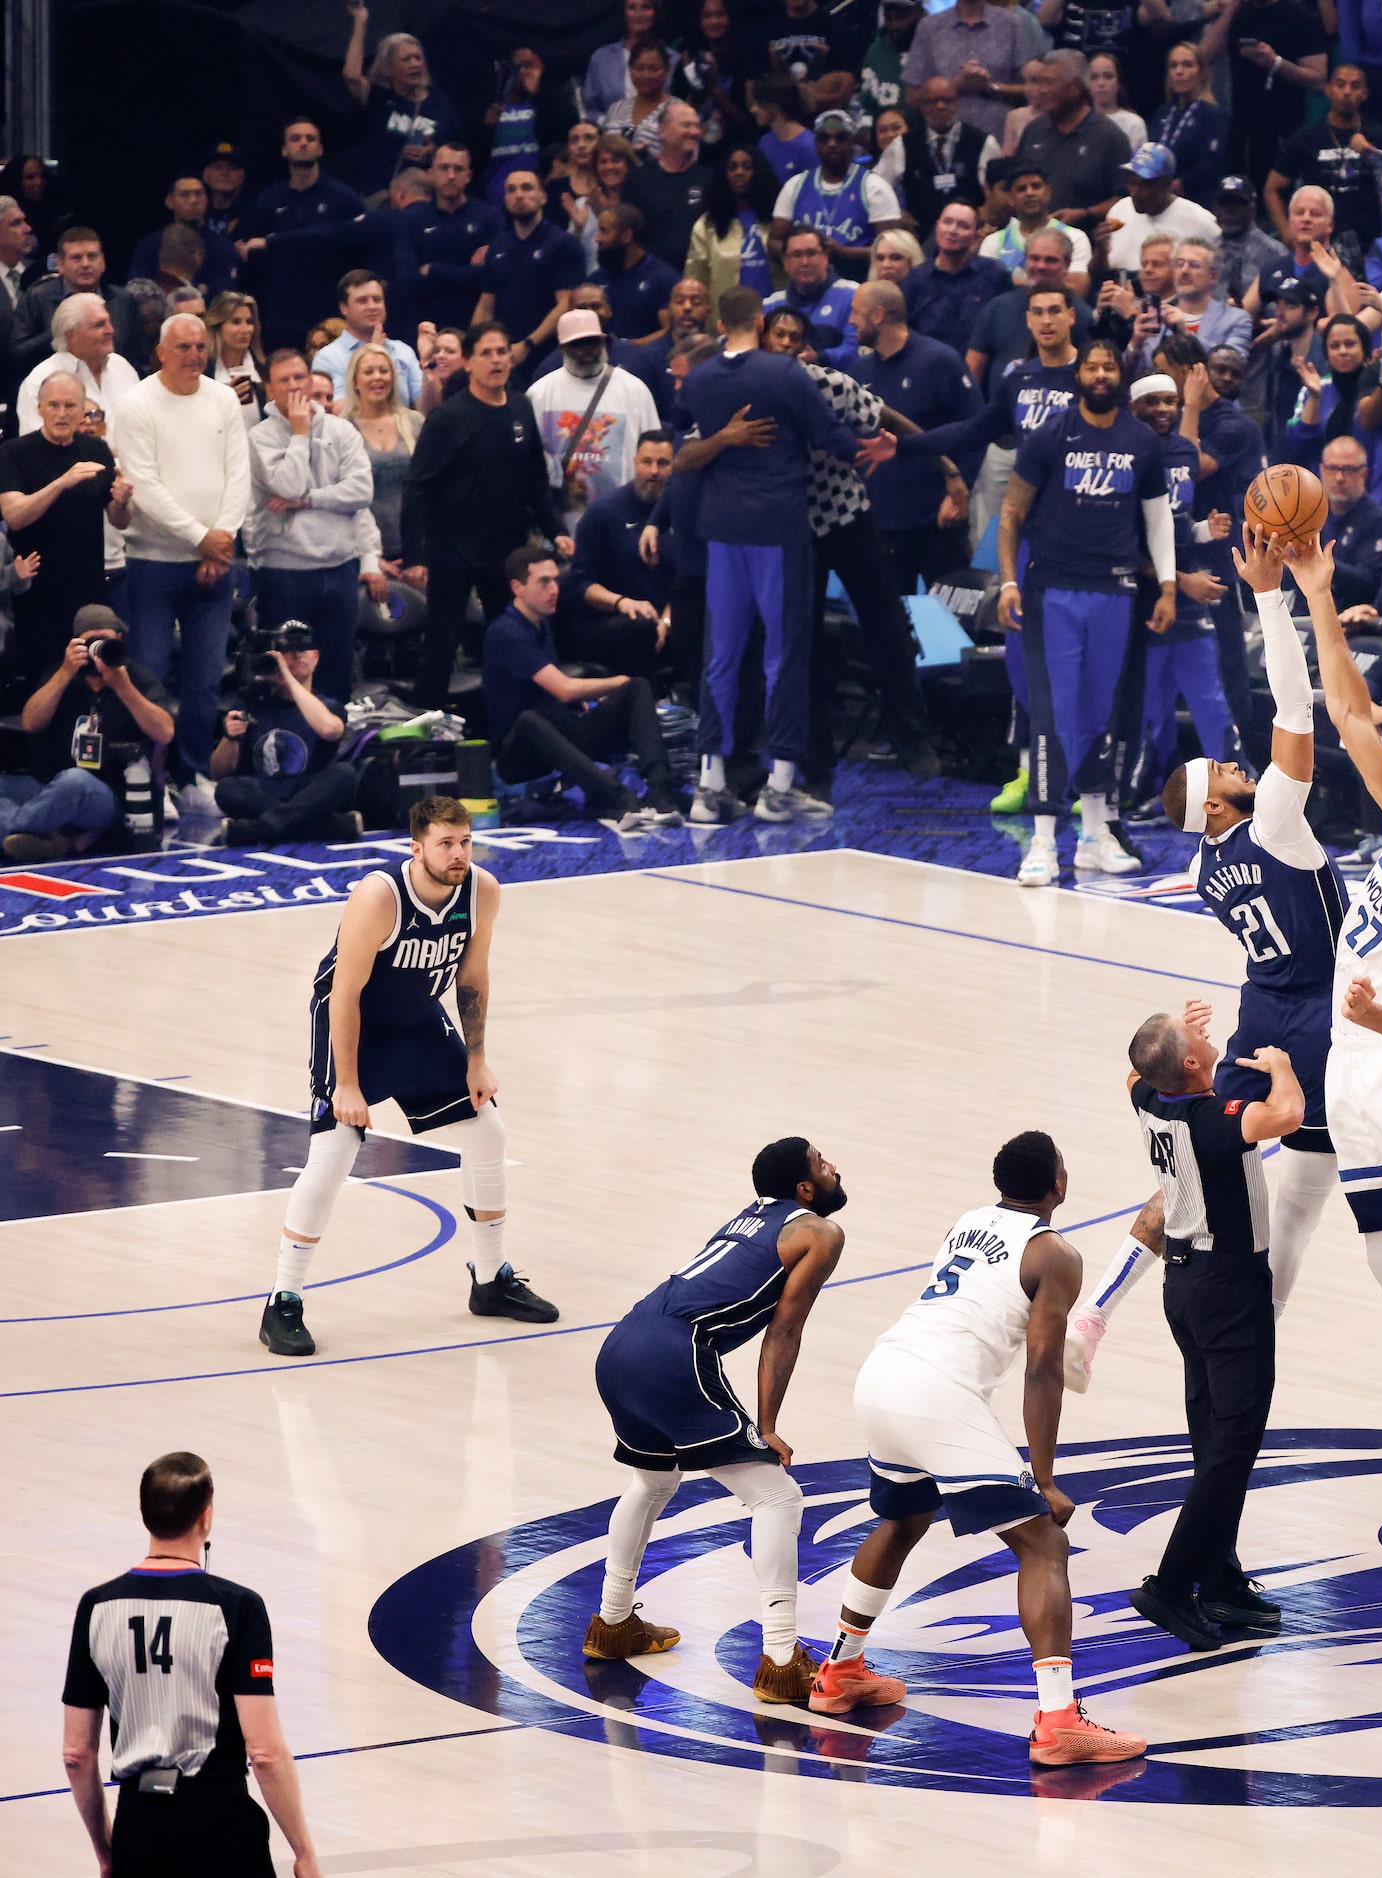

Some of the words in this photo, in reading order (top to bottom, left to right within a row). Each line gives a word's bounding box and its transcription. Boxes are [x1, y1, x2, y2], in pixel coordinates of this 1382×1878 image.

[1107, 453, 1135, 470] FOR
[1074, 468, 1116, 496] ALL
[1205, 862, 1262, 902] GAFFORD
[0, 876, 358, 936] ourtsid
[1229, 895, 1292, 963] 21
[392, 931, 467, 969] MAVS
[428, 962, 460, 998] 77
[1148, 1127, 1177, 1178] 48
[724, 1216, 766, 1239] IRVING
[948, 1229, 1010, 1265] EDWARDS
[670, 1239, 740, 1281] 11
[920, 1254, 976, 1300] 5
[128, 1615, 174, 1674] 14
